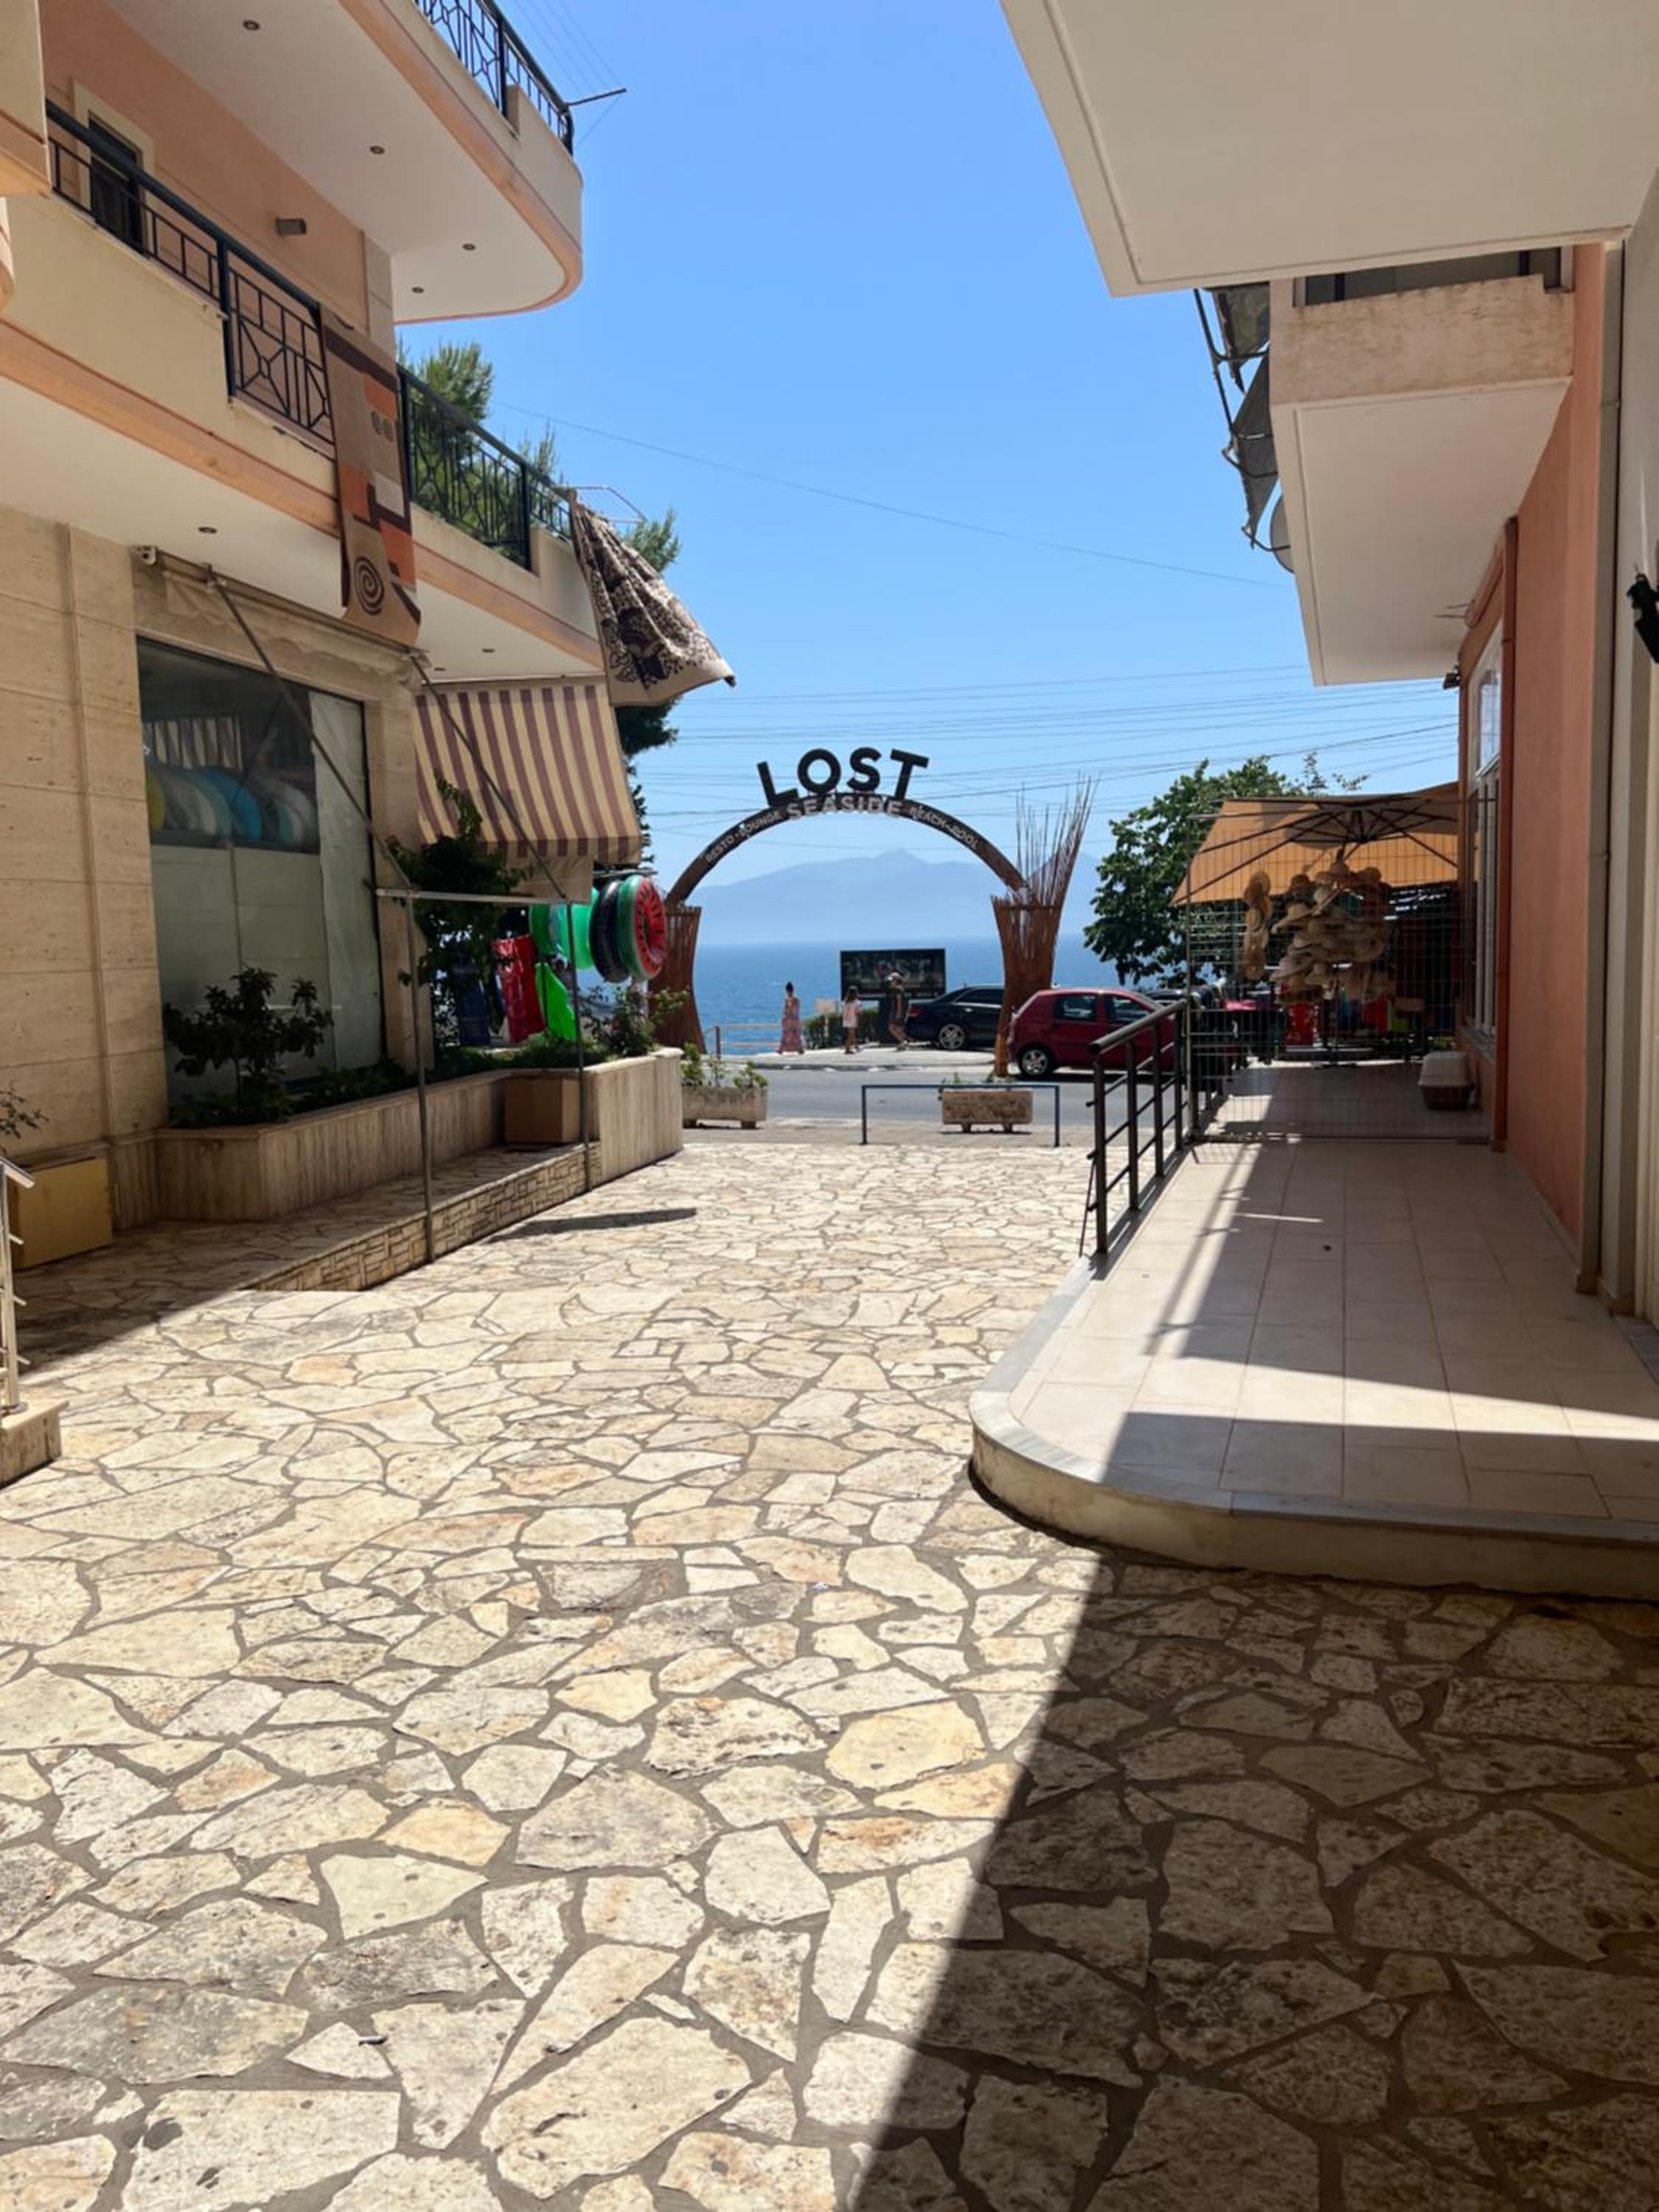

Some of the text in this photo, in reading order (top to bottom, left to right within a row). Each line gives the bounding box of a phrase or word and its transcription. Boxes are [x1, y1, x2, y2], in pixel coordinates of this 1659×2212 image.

[757, 747, 929, 806] LOST
[786, 794, 904, 821] SEASIDE
[909, 806, 947, 829] BEACH
[705, 810, 782, 863] RESTO LOUNGE
